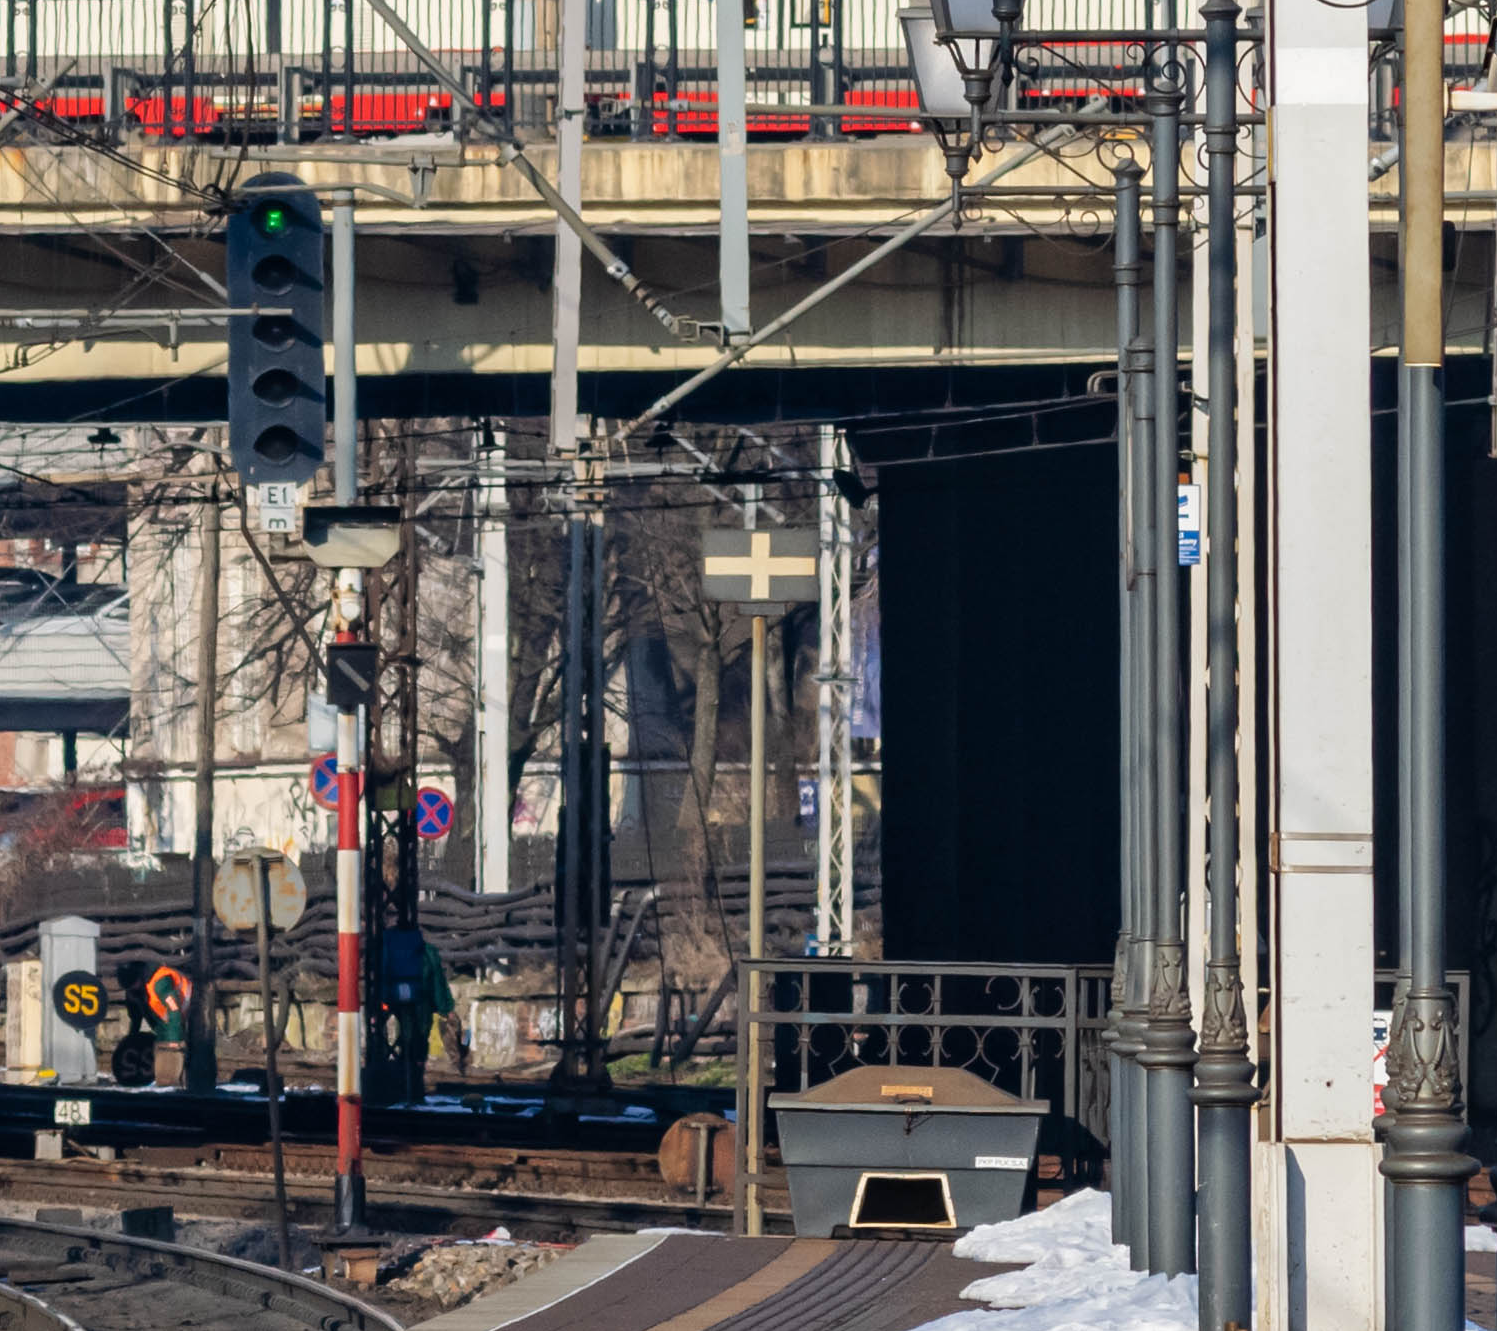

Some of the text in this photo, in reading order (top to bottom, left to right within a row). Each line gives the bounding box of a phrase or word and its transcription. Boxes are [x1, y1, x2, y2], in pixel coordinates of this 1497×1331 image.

[267, 485, 288, 505] E1
[268, 517, 288, 530] m
[63, 982, 100, 1017] S5
